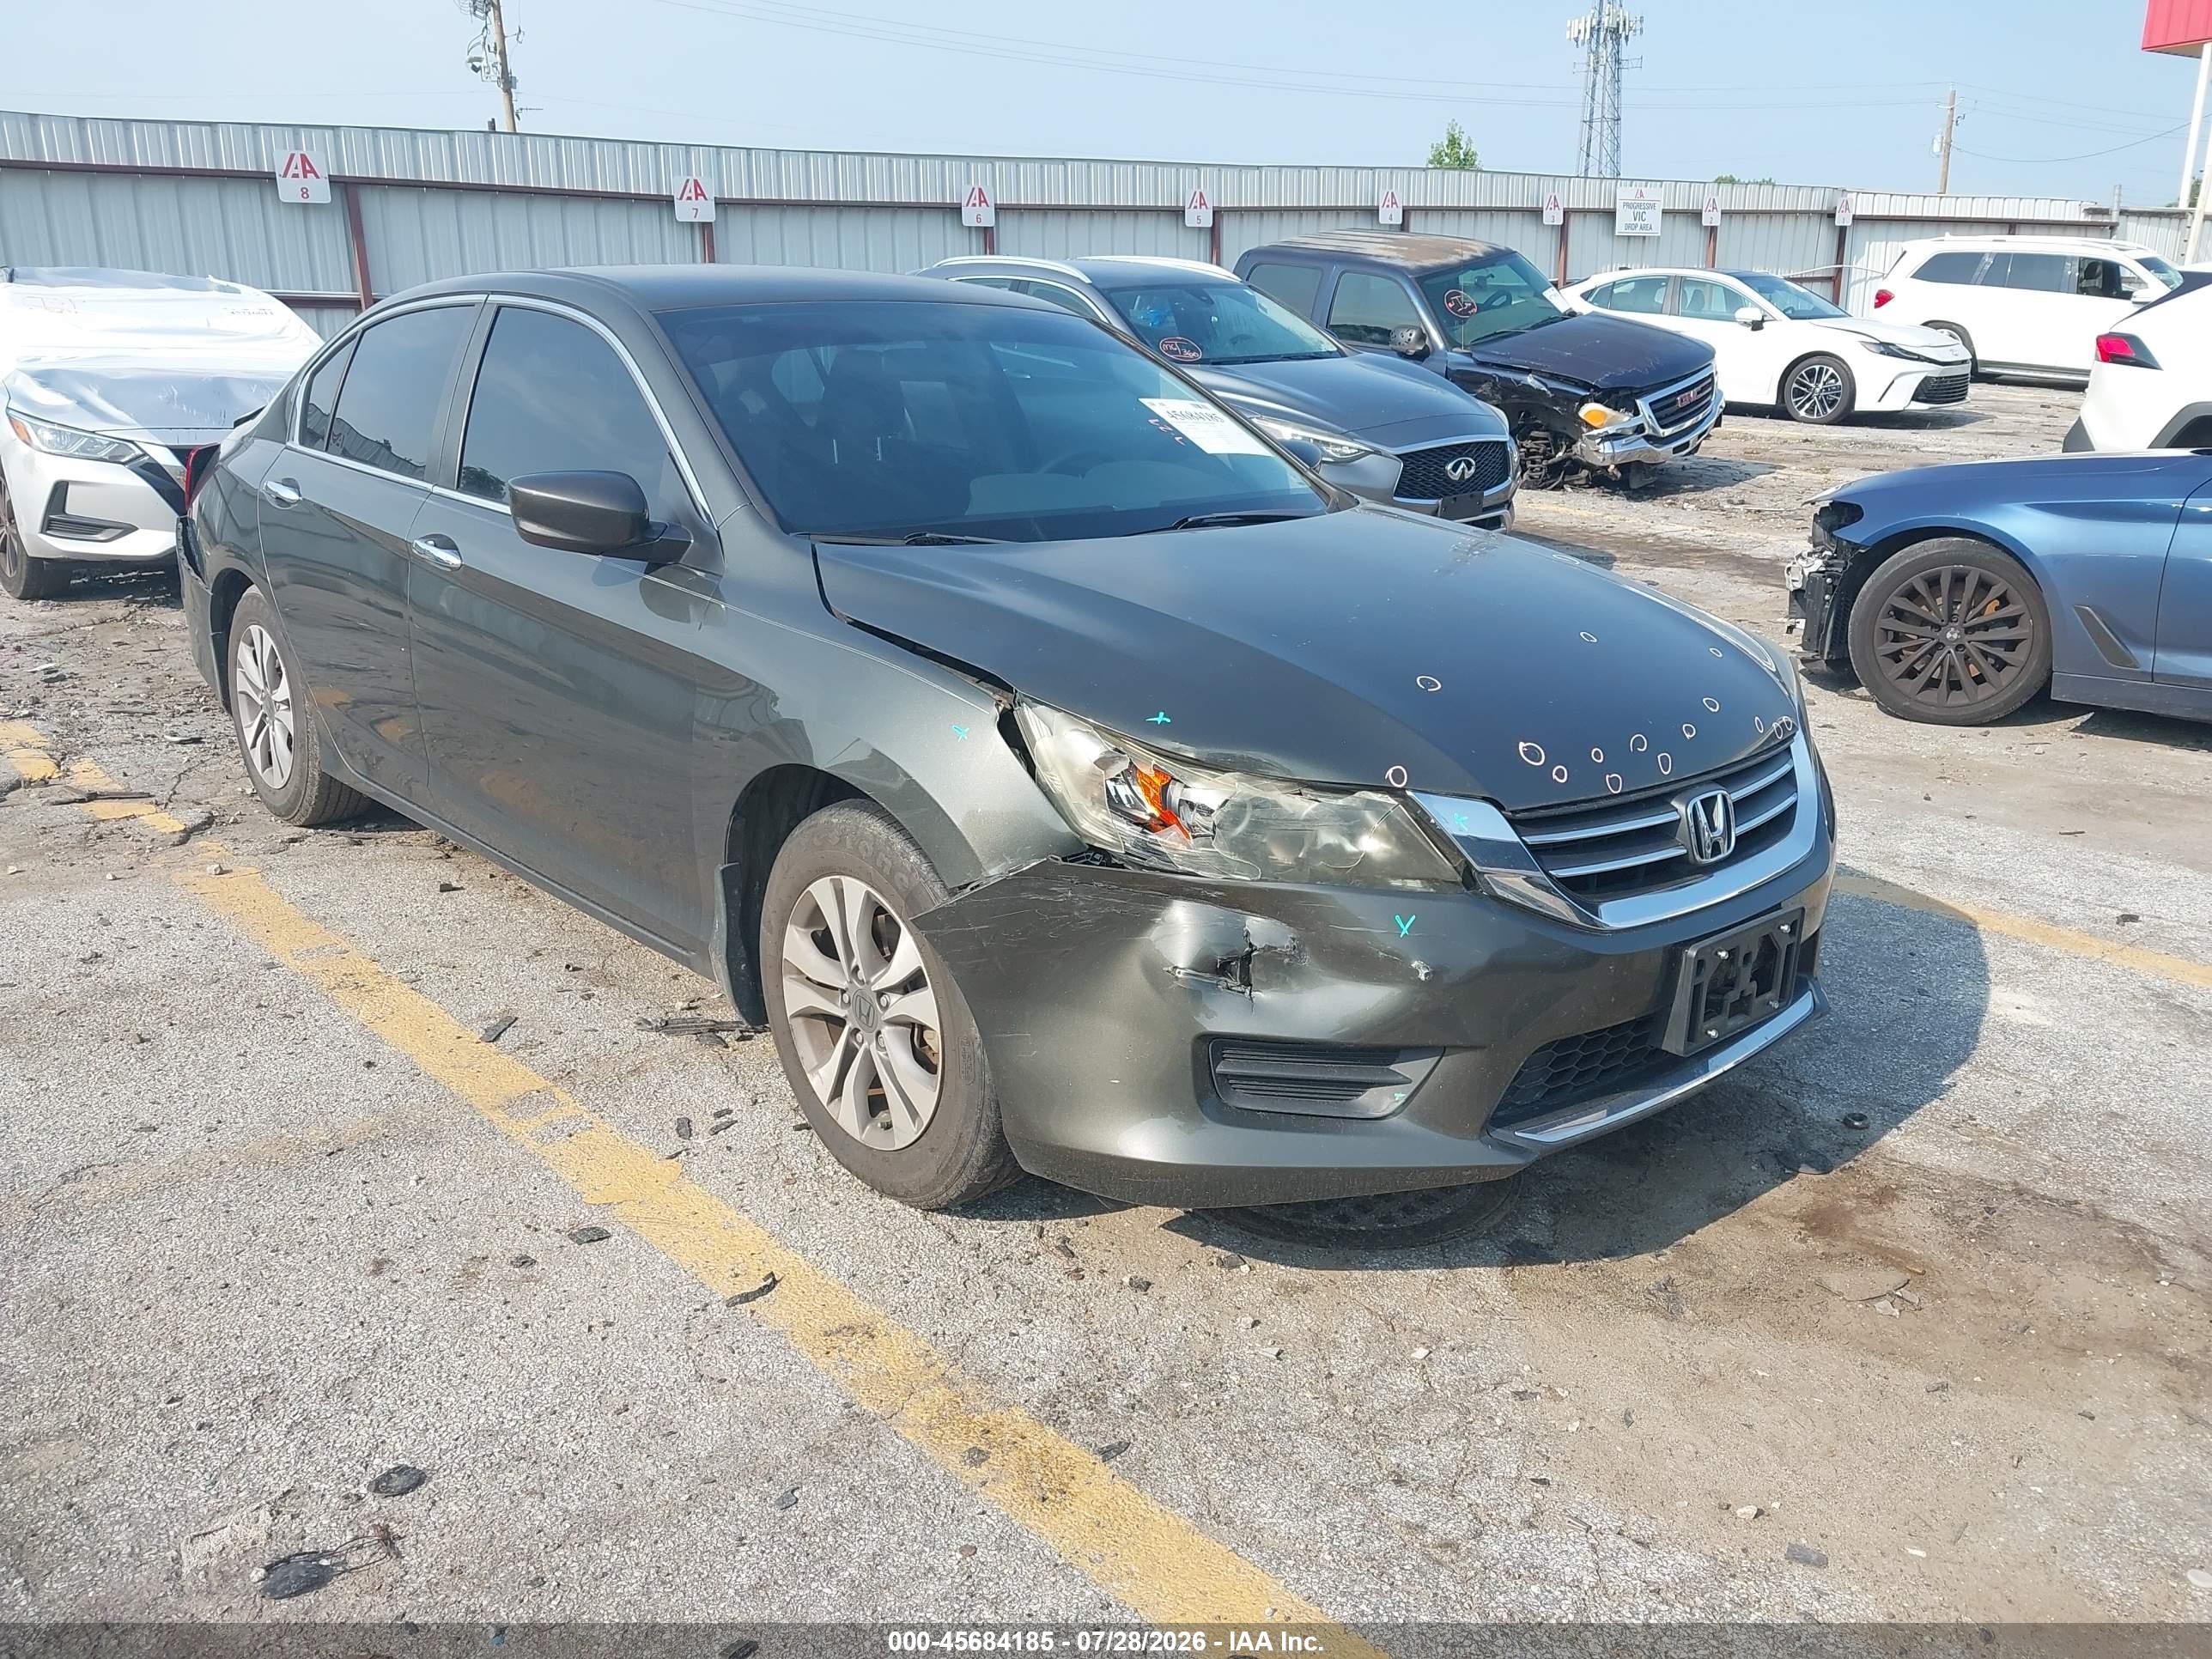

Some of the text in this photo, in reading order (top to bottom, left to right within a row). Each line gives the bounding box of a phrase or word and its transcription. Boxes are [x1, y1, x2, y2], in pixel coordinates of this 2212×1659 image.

[301, 186, 310, 199] 8
[1623, 202, 1656, 210] PROGRESSIVE
[692, 208, 699, 218] 7
[1633, 211, 1646, 222] VIC
[975, 214, 982, 223] 6
[1196, 216, 1202, 224] 5
